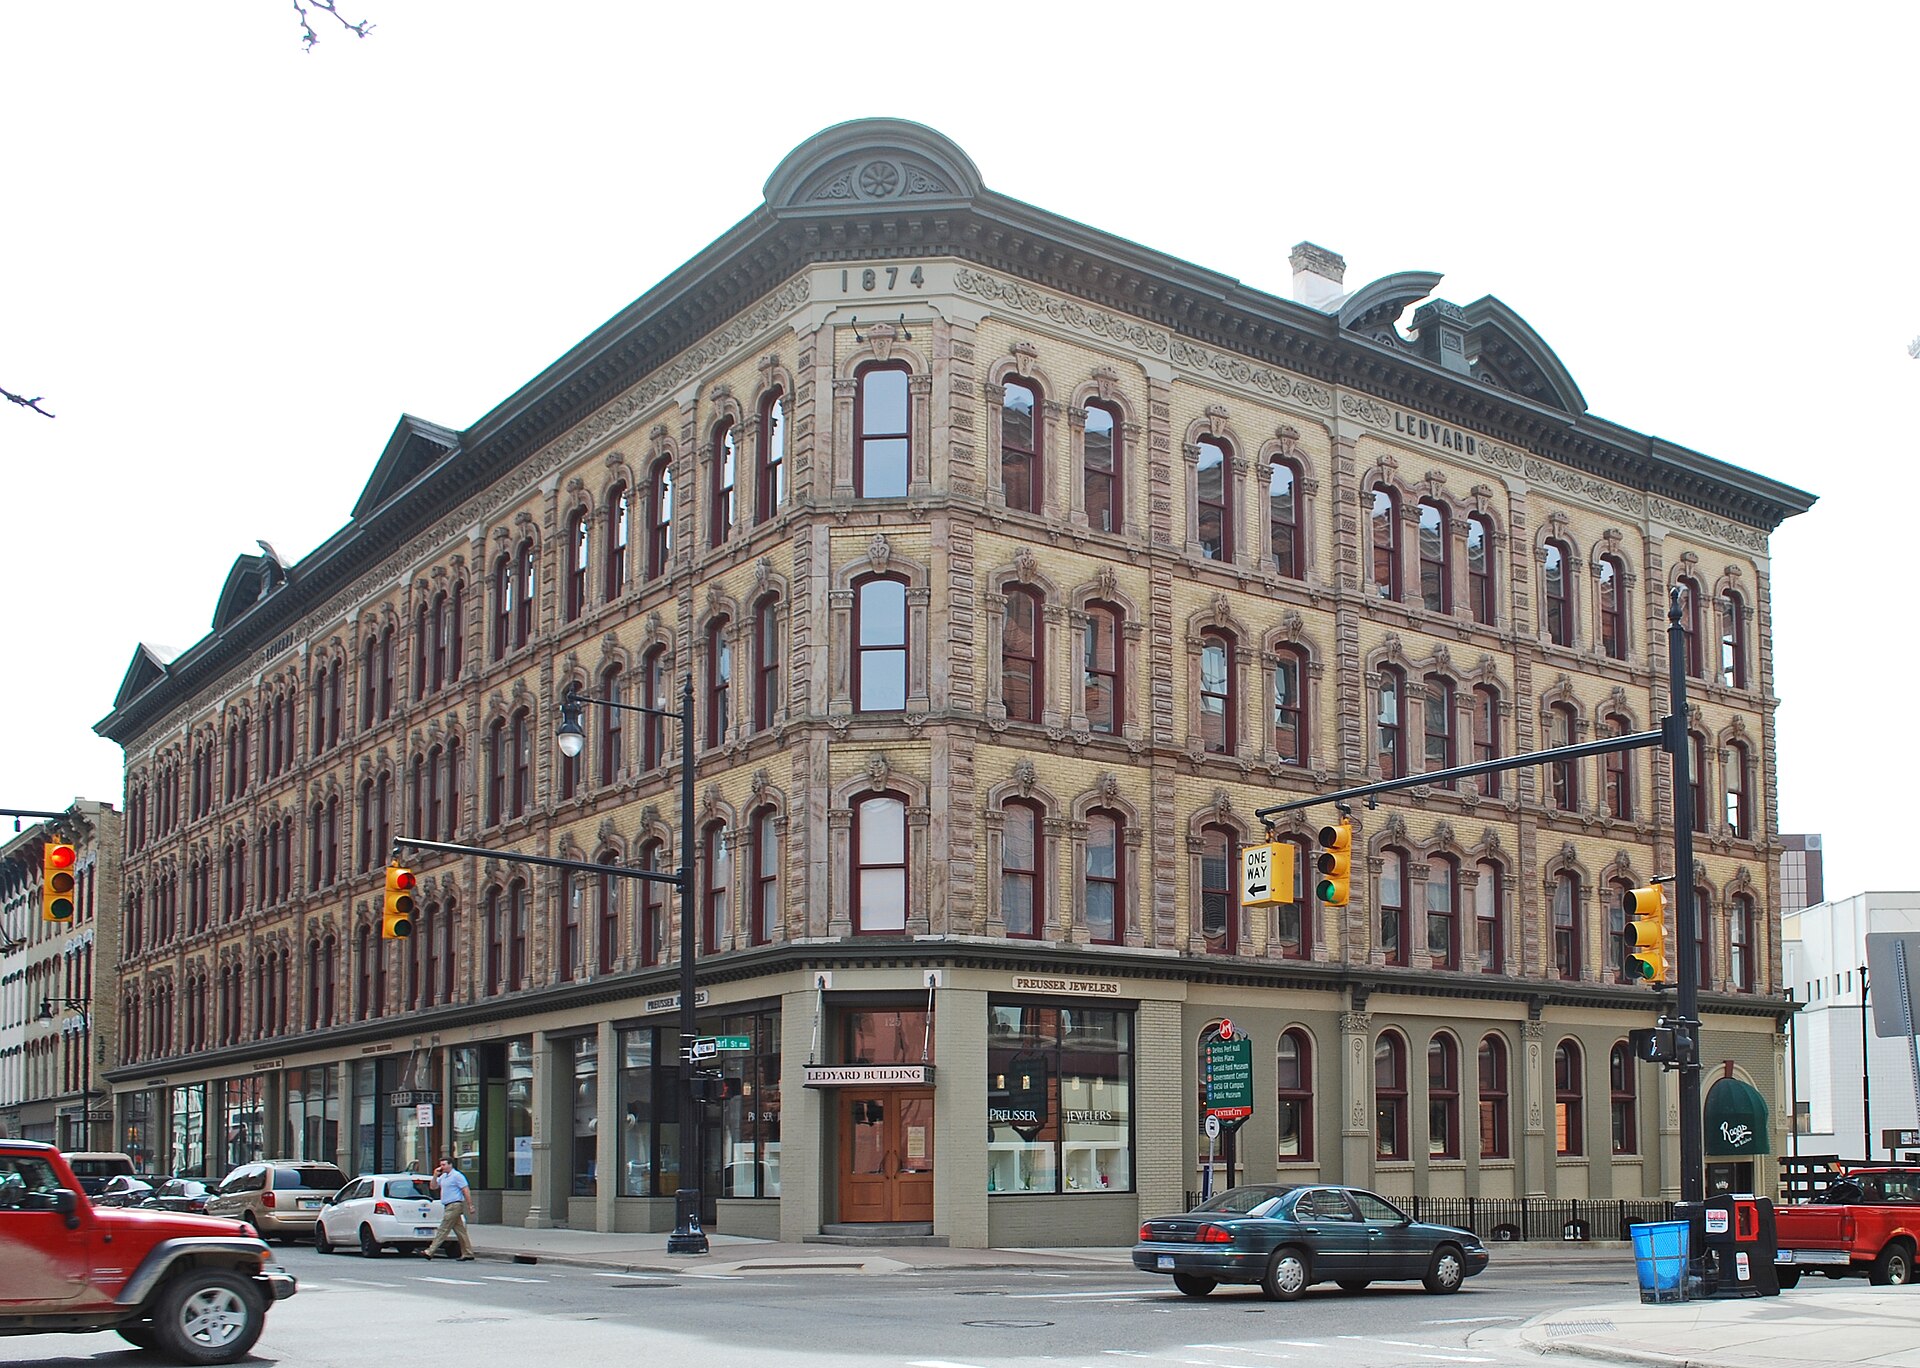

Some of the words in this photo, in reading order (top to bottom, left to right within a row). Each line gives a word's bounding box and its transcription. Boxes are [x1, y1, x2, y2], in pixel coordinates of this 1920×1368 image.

[841, 266, 925, 292] 1874
[1395, 410, 1476, 456] LEDYARD
[1247, 850, 1267, 866] ONE
[1247, 865, 1268, 880] WAY
[1016, 978, 1067, 991] PREUSSER
[1069, 981, 1118, 993] JEWELERS
[884, 1017, 901, 1027] 125
[716, 1038, 727, 1048] arl
[1233, 1063, 1249, 1071] Museum
[807, 1071, 861, 1081] LEDYARD
[863, 1069, 921, 1080] BUILDING
[1225, 1091, 1242, 1099] Museum
[989, 1108, 1038, 1123] PREUSSER
[1066, 1110, 1112, 1123] JEWELERS
